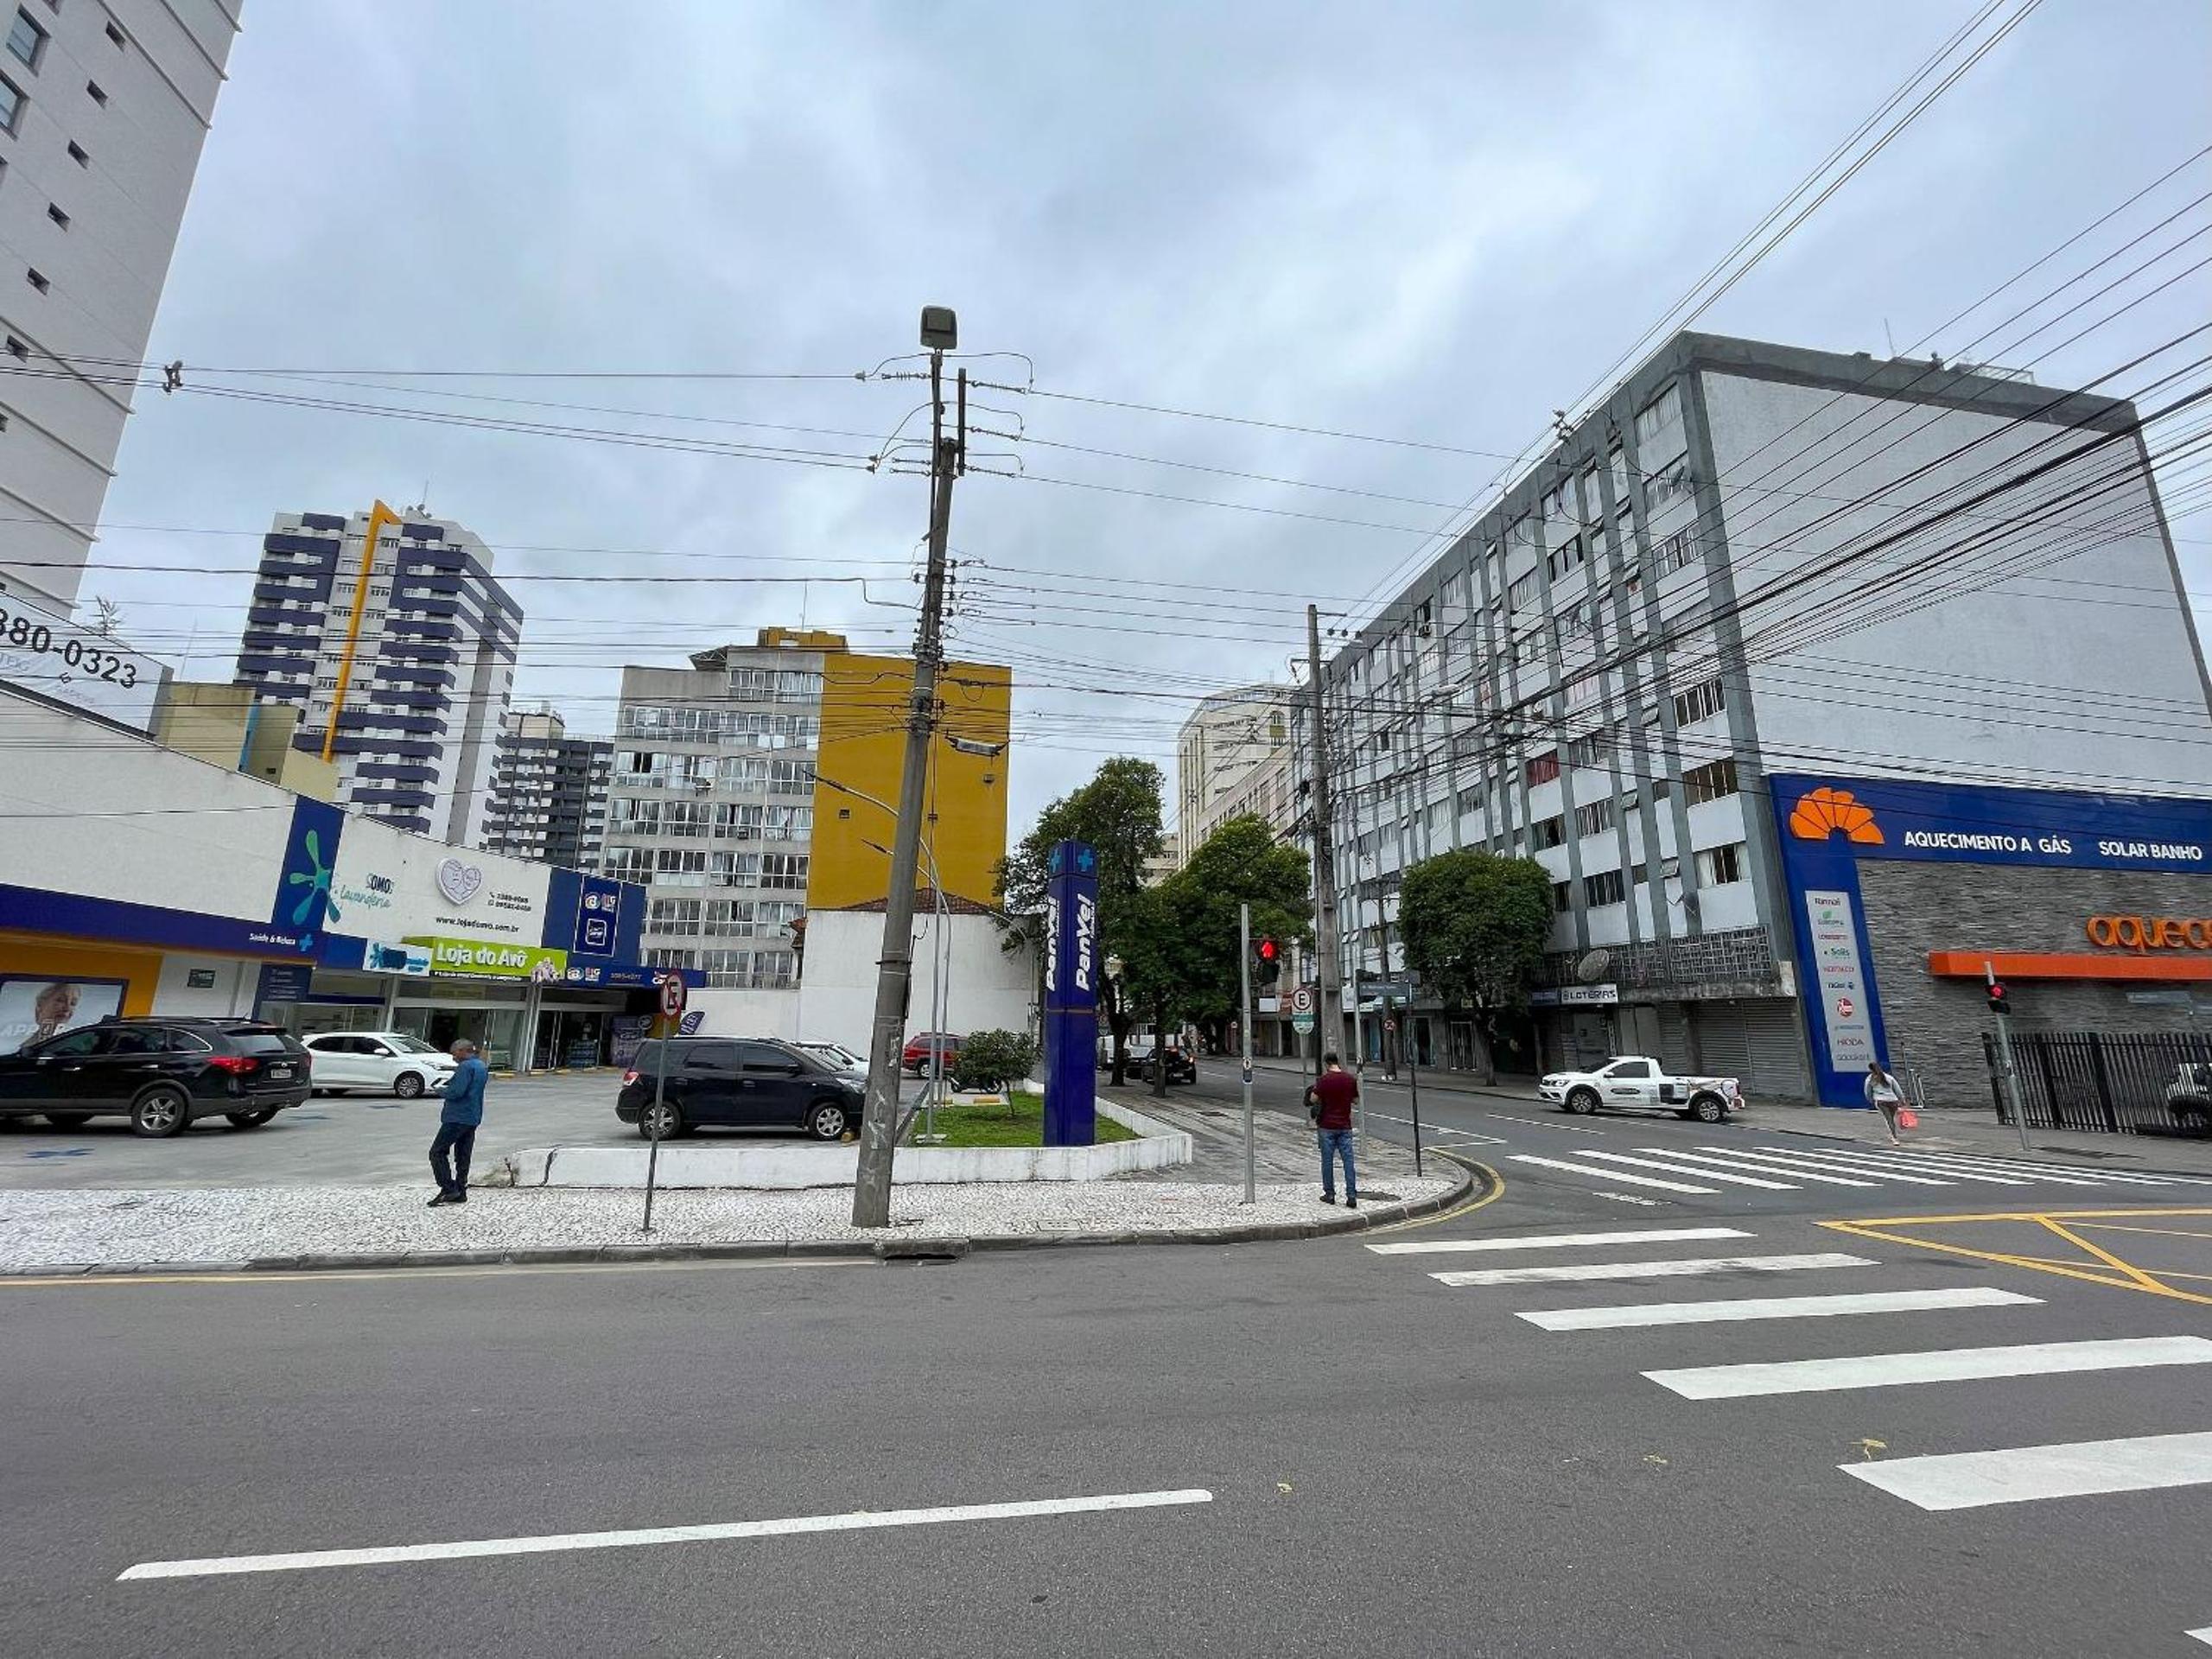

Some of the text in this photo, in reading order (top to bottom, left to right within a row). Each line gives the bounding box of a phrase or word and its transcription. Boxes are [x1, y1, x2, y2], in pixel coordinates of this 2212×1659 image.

[1904, 831, 2072, 855] AQUECIMENTO A GÁS
[2099, 841, 2203, 861] SOLAR BANHO
[436, 943, 472, 966] Loja
[476, 945, 496, 965] do
[498, 950, 528, 968] Avô
[1299, 993, 1306, 1005] E
